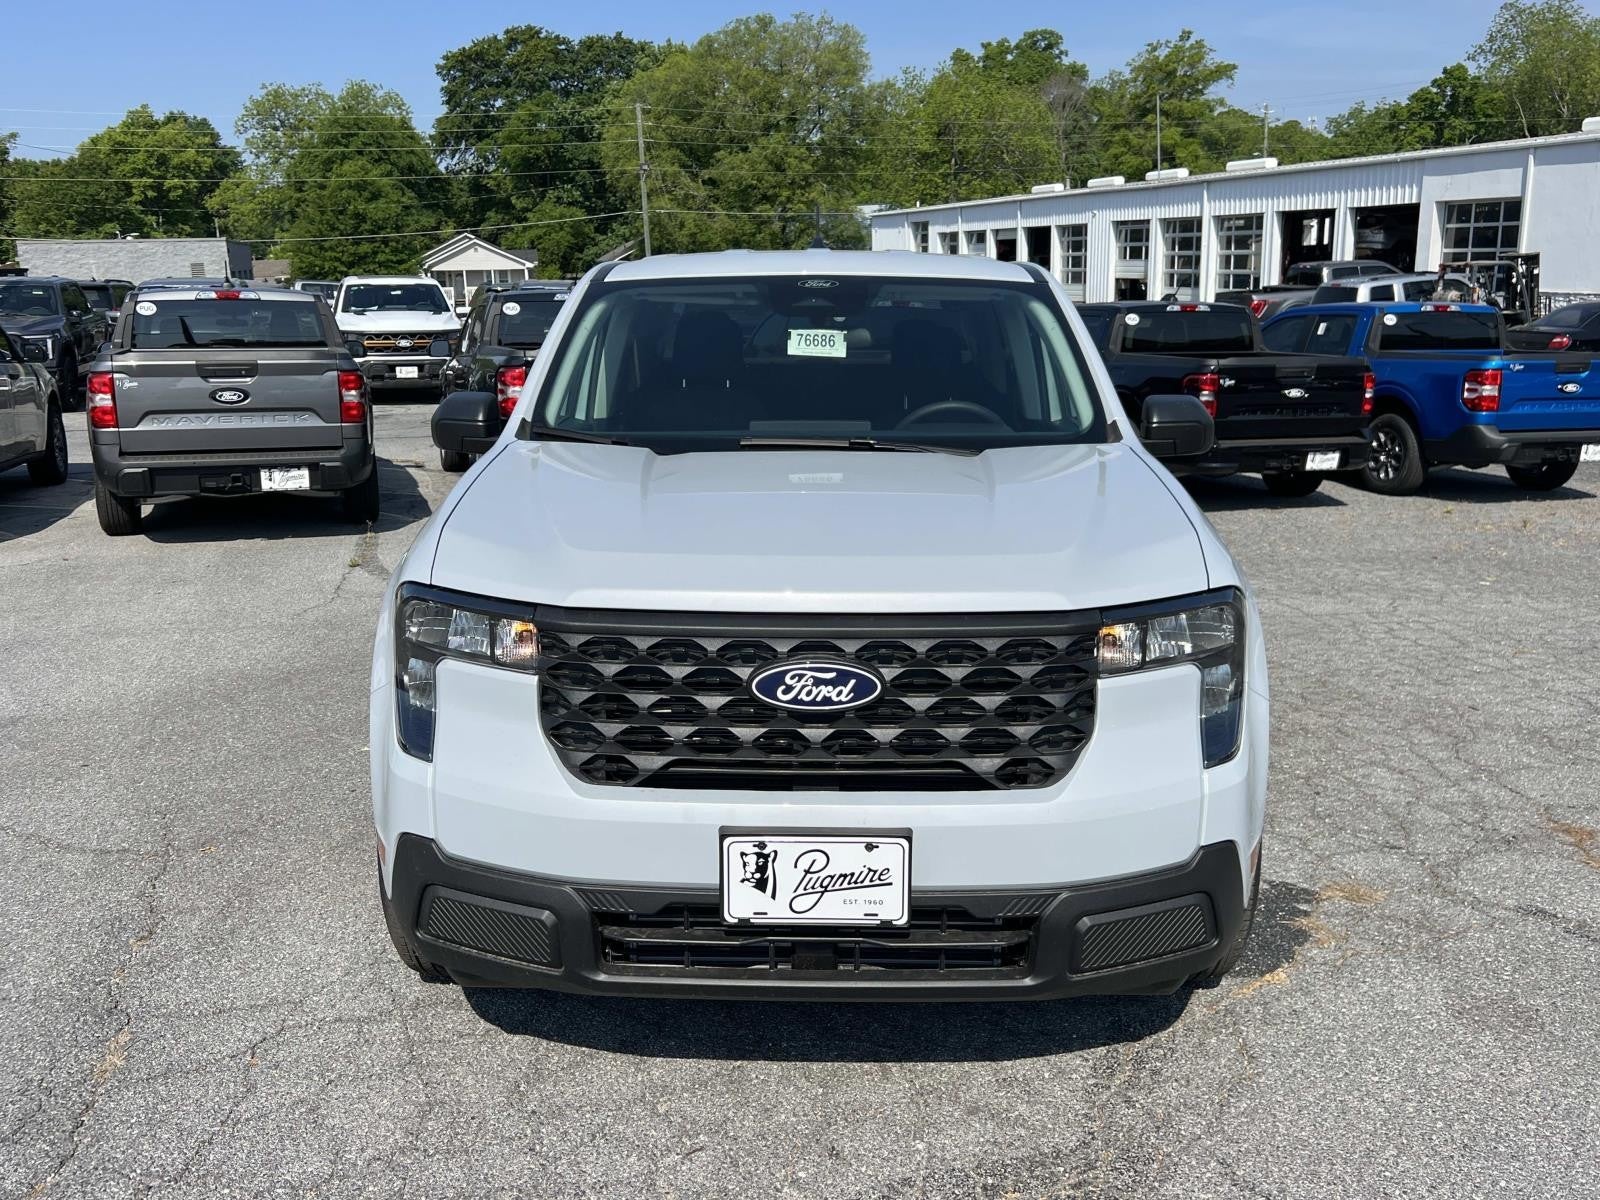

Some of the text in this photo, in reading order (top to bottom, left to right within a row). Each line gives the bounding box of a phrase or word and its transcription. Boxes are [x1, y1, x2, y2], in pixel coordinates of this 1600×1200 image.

[804, 279, 832, 288] Ford
[796, 333, 836, 348] 76686
[152, 414, 312, 427] MAVERICK
[777, 670, 857, 702] Ford
[789, 849, 893, 914] Pugmire
